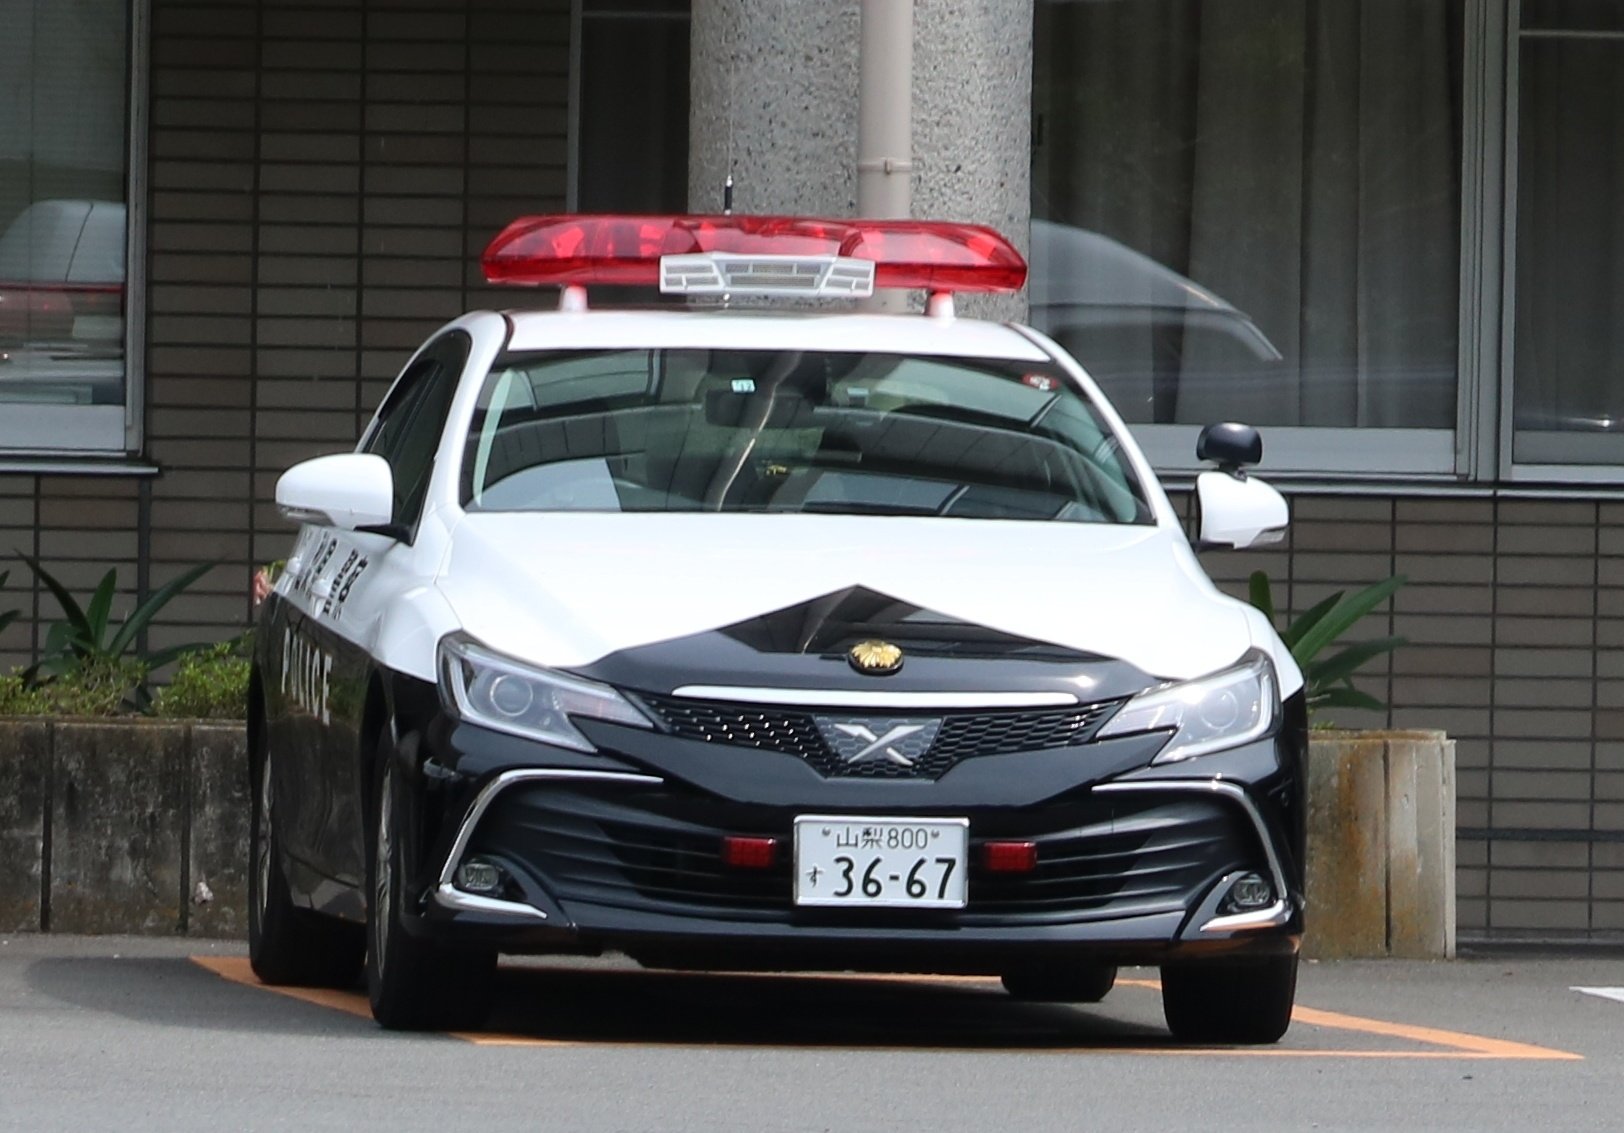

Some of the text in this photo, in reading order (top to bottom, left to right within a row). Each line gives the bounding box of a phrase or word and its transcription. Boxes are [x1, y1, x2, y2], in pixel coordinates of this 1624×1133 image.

[281, 627, 333, 727] POLICE
[836, 827, 928, 850] 山梨800
[806, 856, 957, 899] す 36-67
